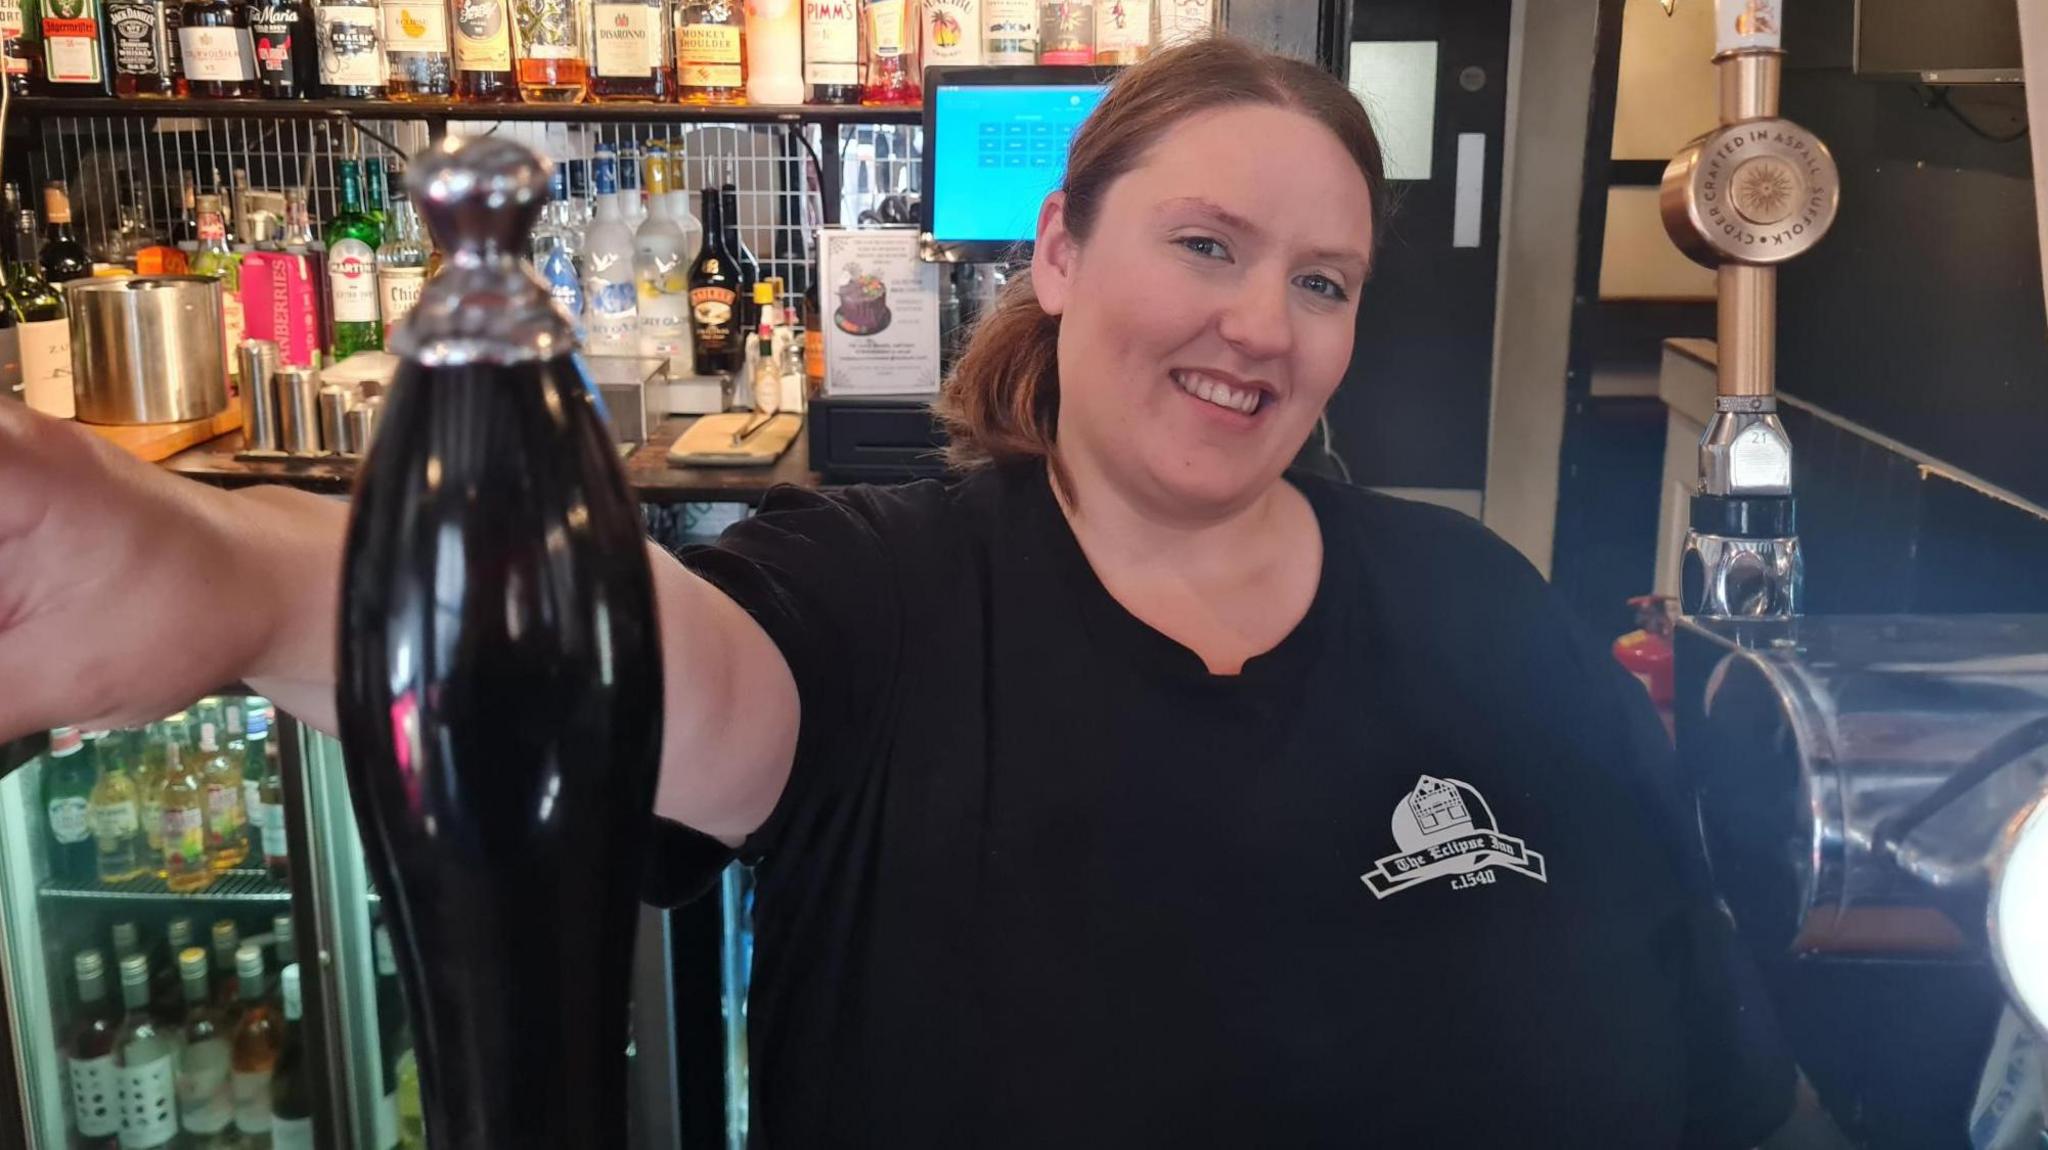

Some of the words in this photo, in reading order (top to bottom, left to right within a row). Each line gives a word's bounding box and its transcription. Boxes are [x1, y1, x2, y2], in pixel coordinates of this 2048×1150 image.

[260, 4, 299, 23] Maria
[333, 33, 374, 41] KRAKEN
[600, 29, 646, 39] DISARONNO
[680, 39, 731, 48] SHOULDER
[682, 29, 726, 39] MONKEY
[1750, 130, 1768, 142] IN
[1774, 136, 1821, 176] ASPALL
[1704, 136, 1745, 201] CRAFTED
[1773, 187, 1825, 246] SUFFOLK
[1709, 211, 1755, 245] CYDER
[1751, 431, 1768, 444] 21
[1394, 855, 1426, 872] The
[1428, 836, 1486, 861] Eclipse
[1490, 835, 1516, 856] Inn
[1450, 869, 1497, 890] c.1540
